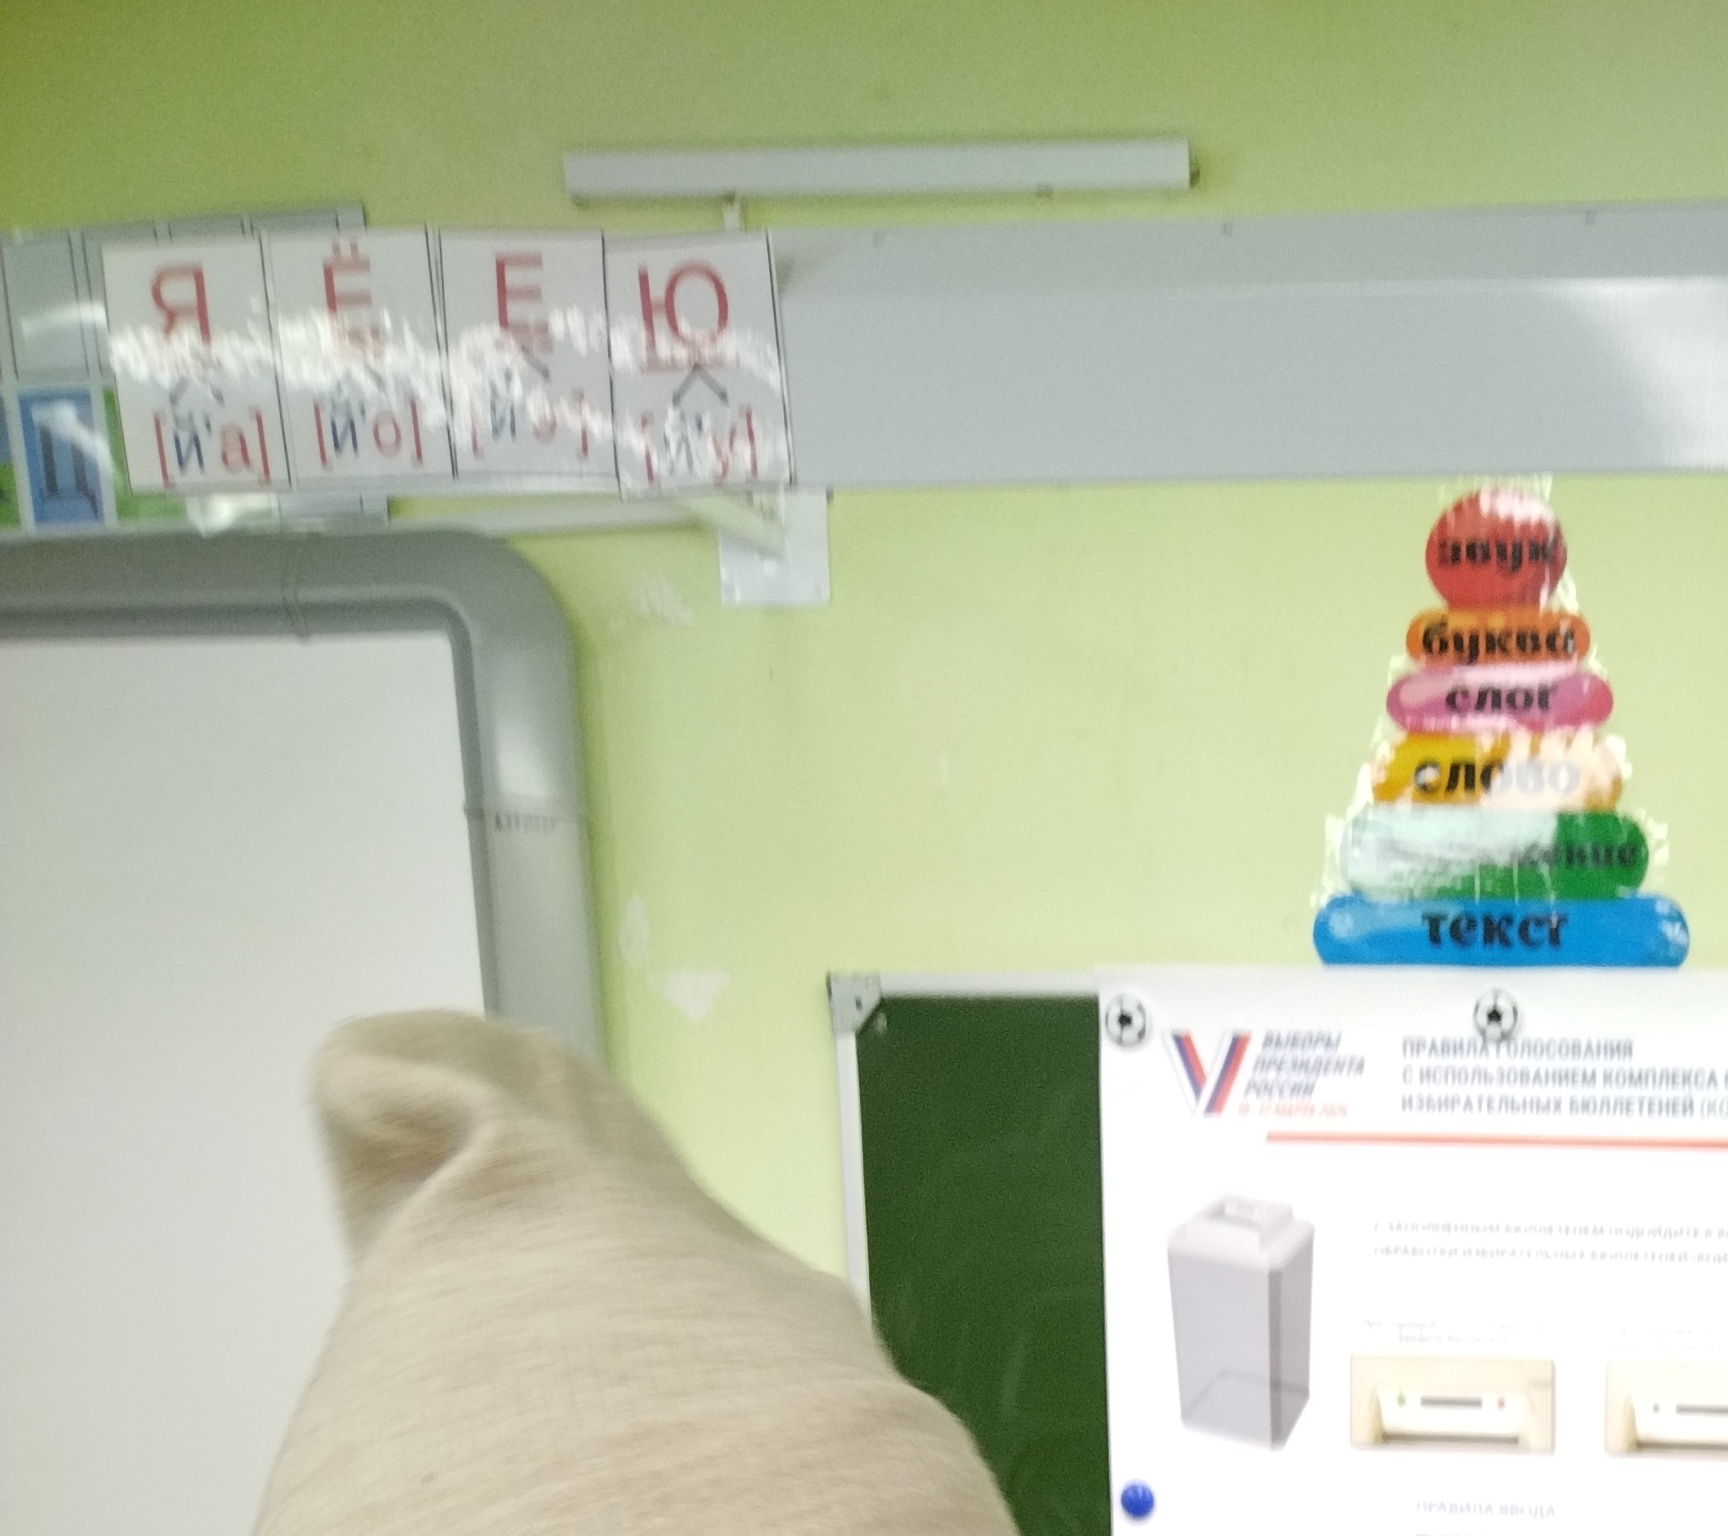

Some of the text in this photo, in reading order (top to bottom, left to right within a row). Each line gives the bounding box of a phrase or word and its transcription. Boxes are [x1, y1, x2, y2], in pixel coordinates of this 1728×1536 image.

[152, 259, 211, 347] Я
[1421, 615, 1577, 664] буква
[1444, 681, 1558, 714] слог
[1413, 758, 1581, 796] слово
[1421, 910, 1568, 949] текст
[1401, 1035, 1490, 1061] ПРАВИЛА
[1401, 1063, 1414, 1088] С
[1418, 1064, 1598, 1090] ИСПОЛЬЗОВАНИЕМ
[1602, 1066, 1719, 1092] КОМПЛЕКСА
[1401, 1092, 1563, 1116] ИЗБИРАТЕЛЬНЫХ
[1568, 1094, 1695, 1120] БЮЛЛЕТЕНЕЙ
